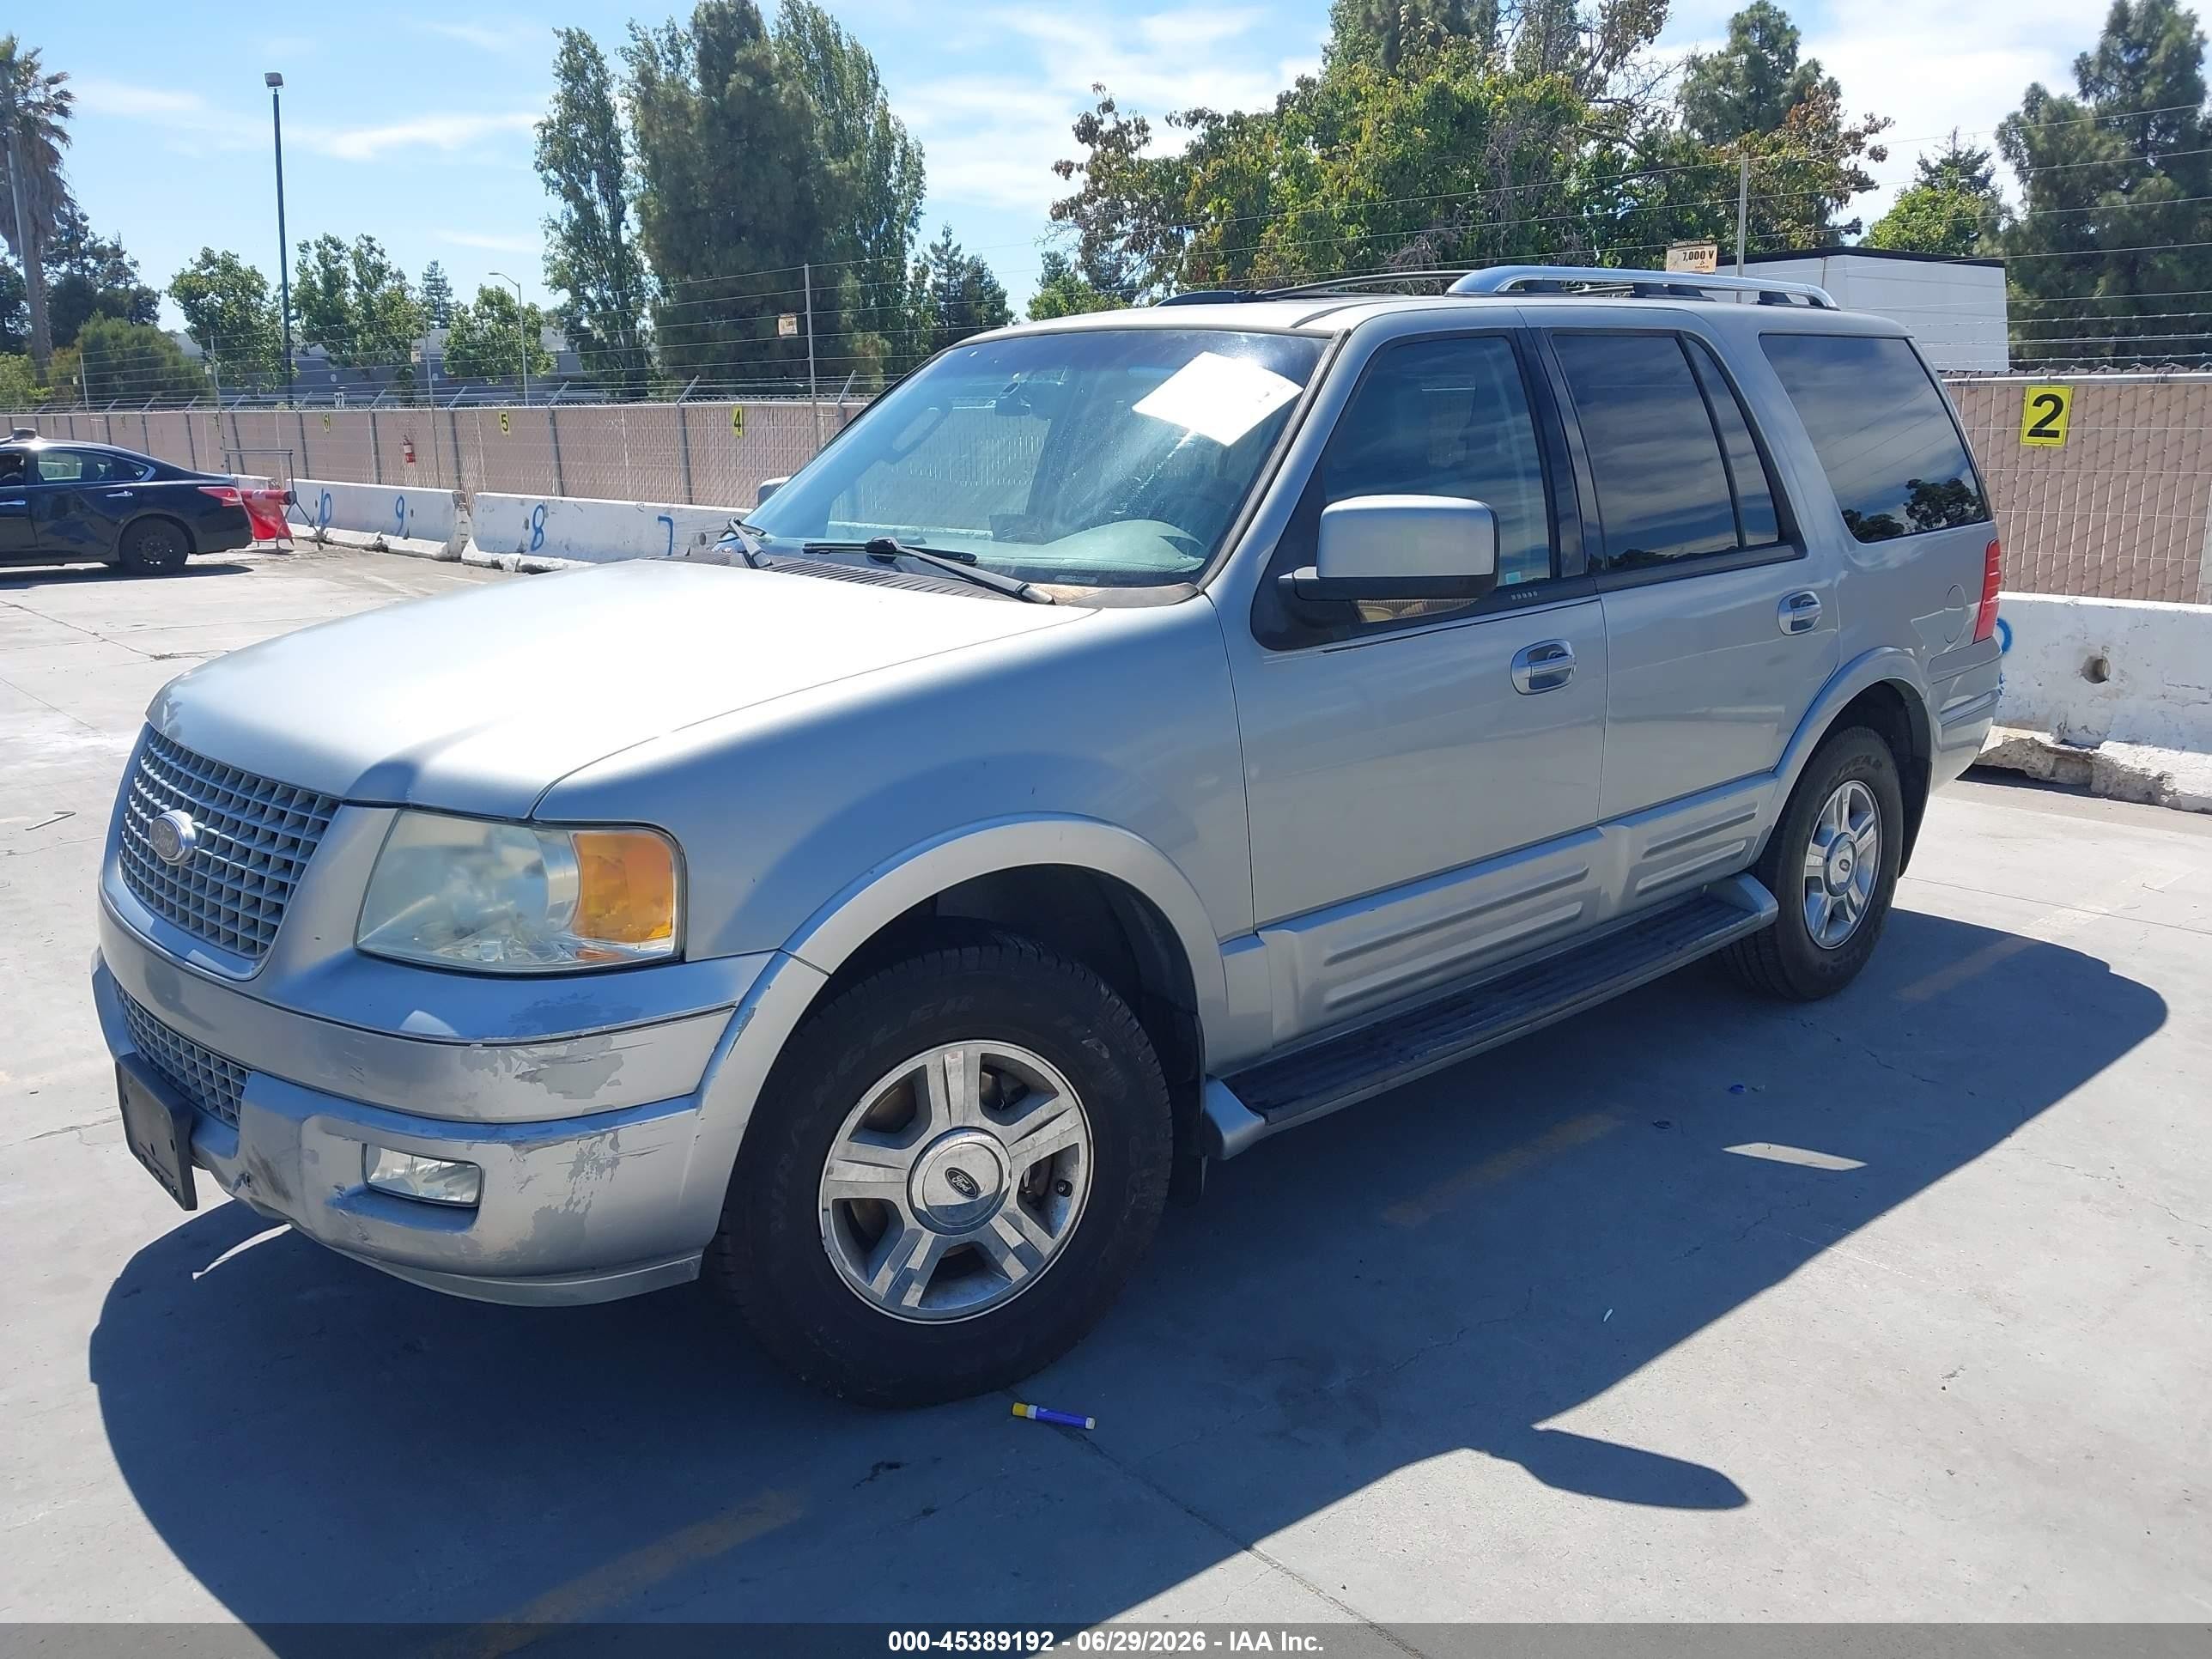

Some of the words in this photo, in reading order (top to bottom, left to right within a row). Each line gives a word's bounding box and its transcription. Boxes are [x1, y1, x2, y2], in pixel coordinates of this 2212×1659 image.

[1682, 252, 1705, 262] 7,000
[1708, 250, 1714, 259] V
[324, 415, 329, 429] 6
[501, 414, 508, 432] 5
[733, 410, 742, 433] 4
[2027, 393, 2064, 438] 2
[395, 494, 405, 536] 9
[531, 504, 544, 551] 8
[657, 515, 674, 556] 7
[155, 822, 175, 851] Ford
[951, 1175, 971, 1192] Ford
